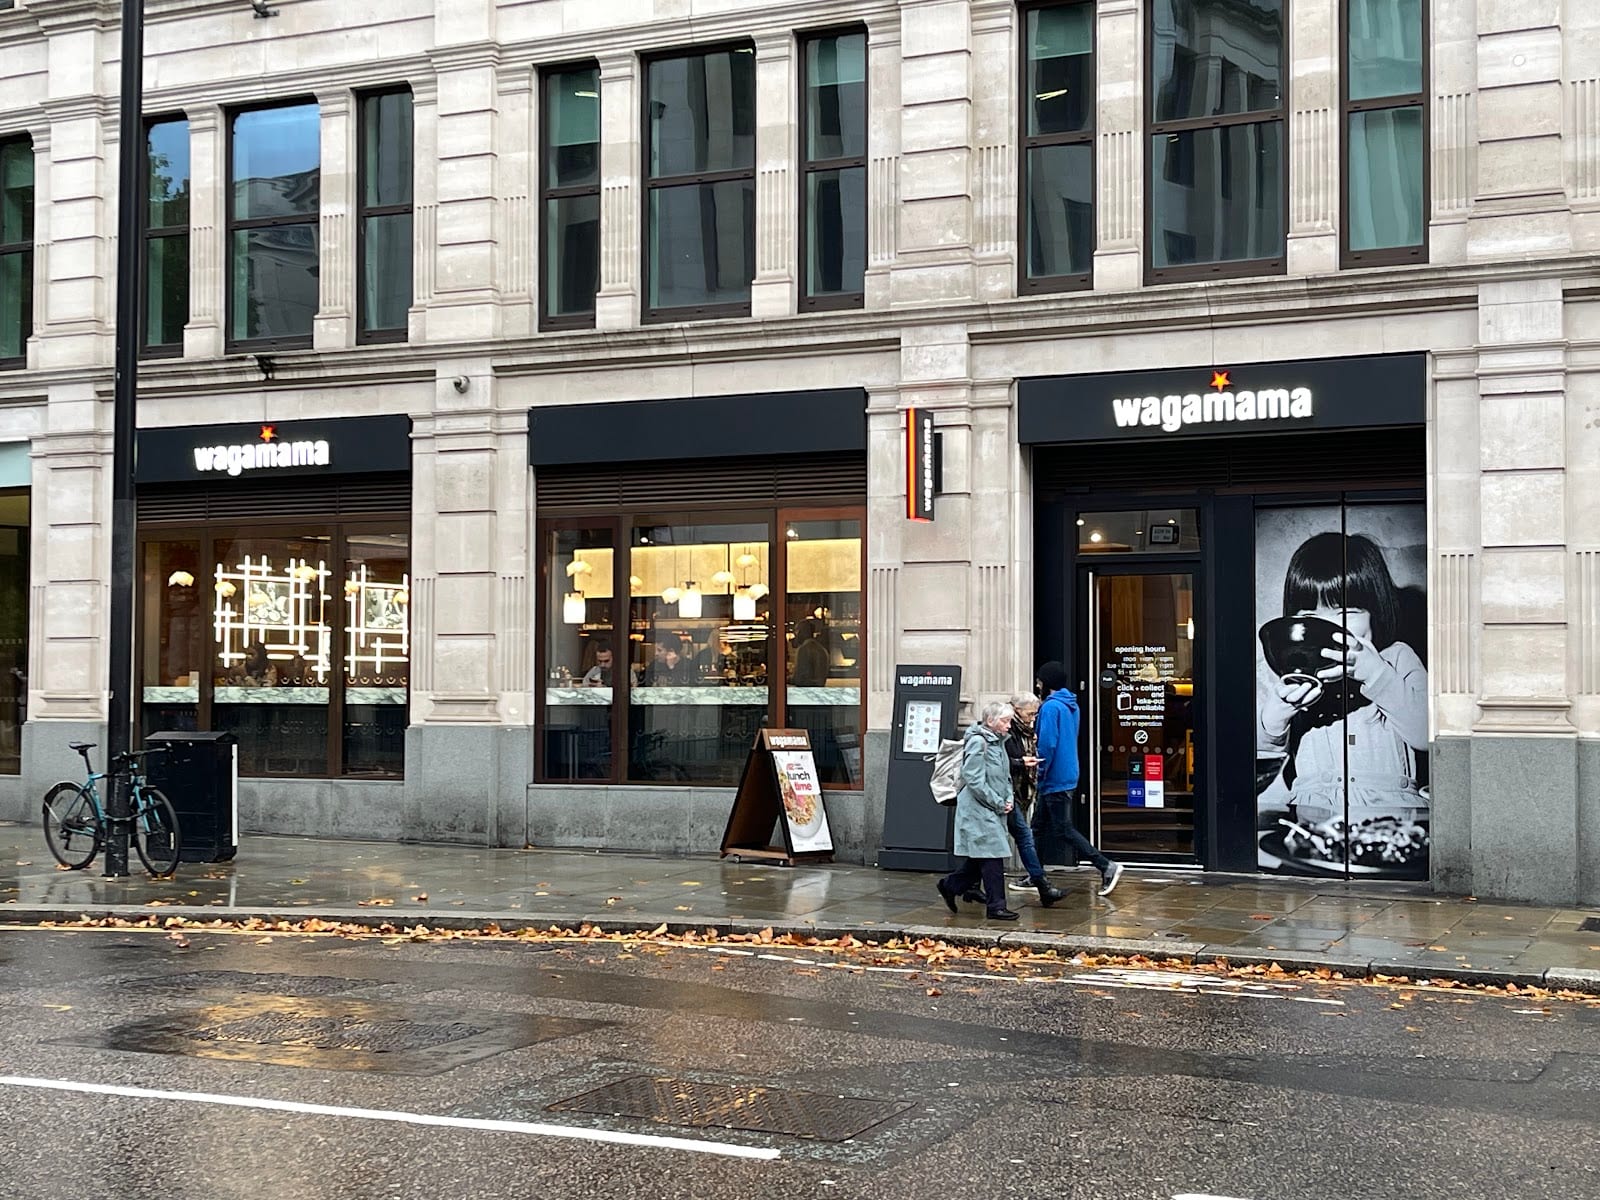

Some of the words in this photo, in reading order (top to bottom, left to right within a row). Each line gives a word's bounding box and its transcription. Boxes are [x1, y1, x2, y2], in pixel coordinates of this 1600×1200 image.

[1112, 387, 1312, 432] wagamama
[194, 440, 330, 476] wagamama
[924, 418, 933, 512] wagamama
[1115, 646, 1144, 654] opening
[899, 676, 953, 686] wagamama
[769, 736, 807, 748] wagamama
[787, 771, 810, 780] lunch
[794, 782, 812, 790] time
